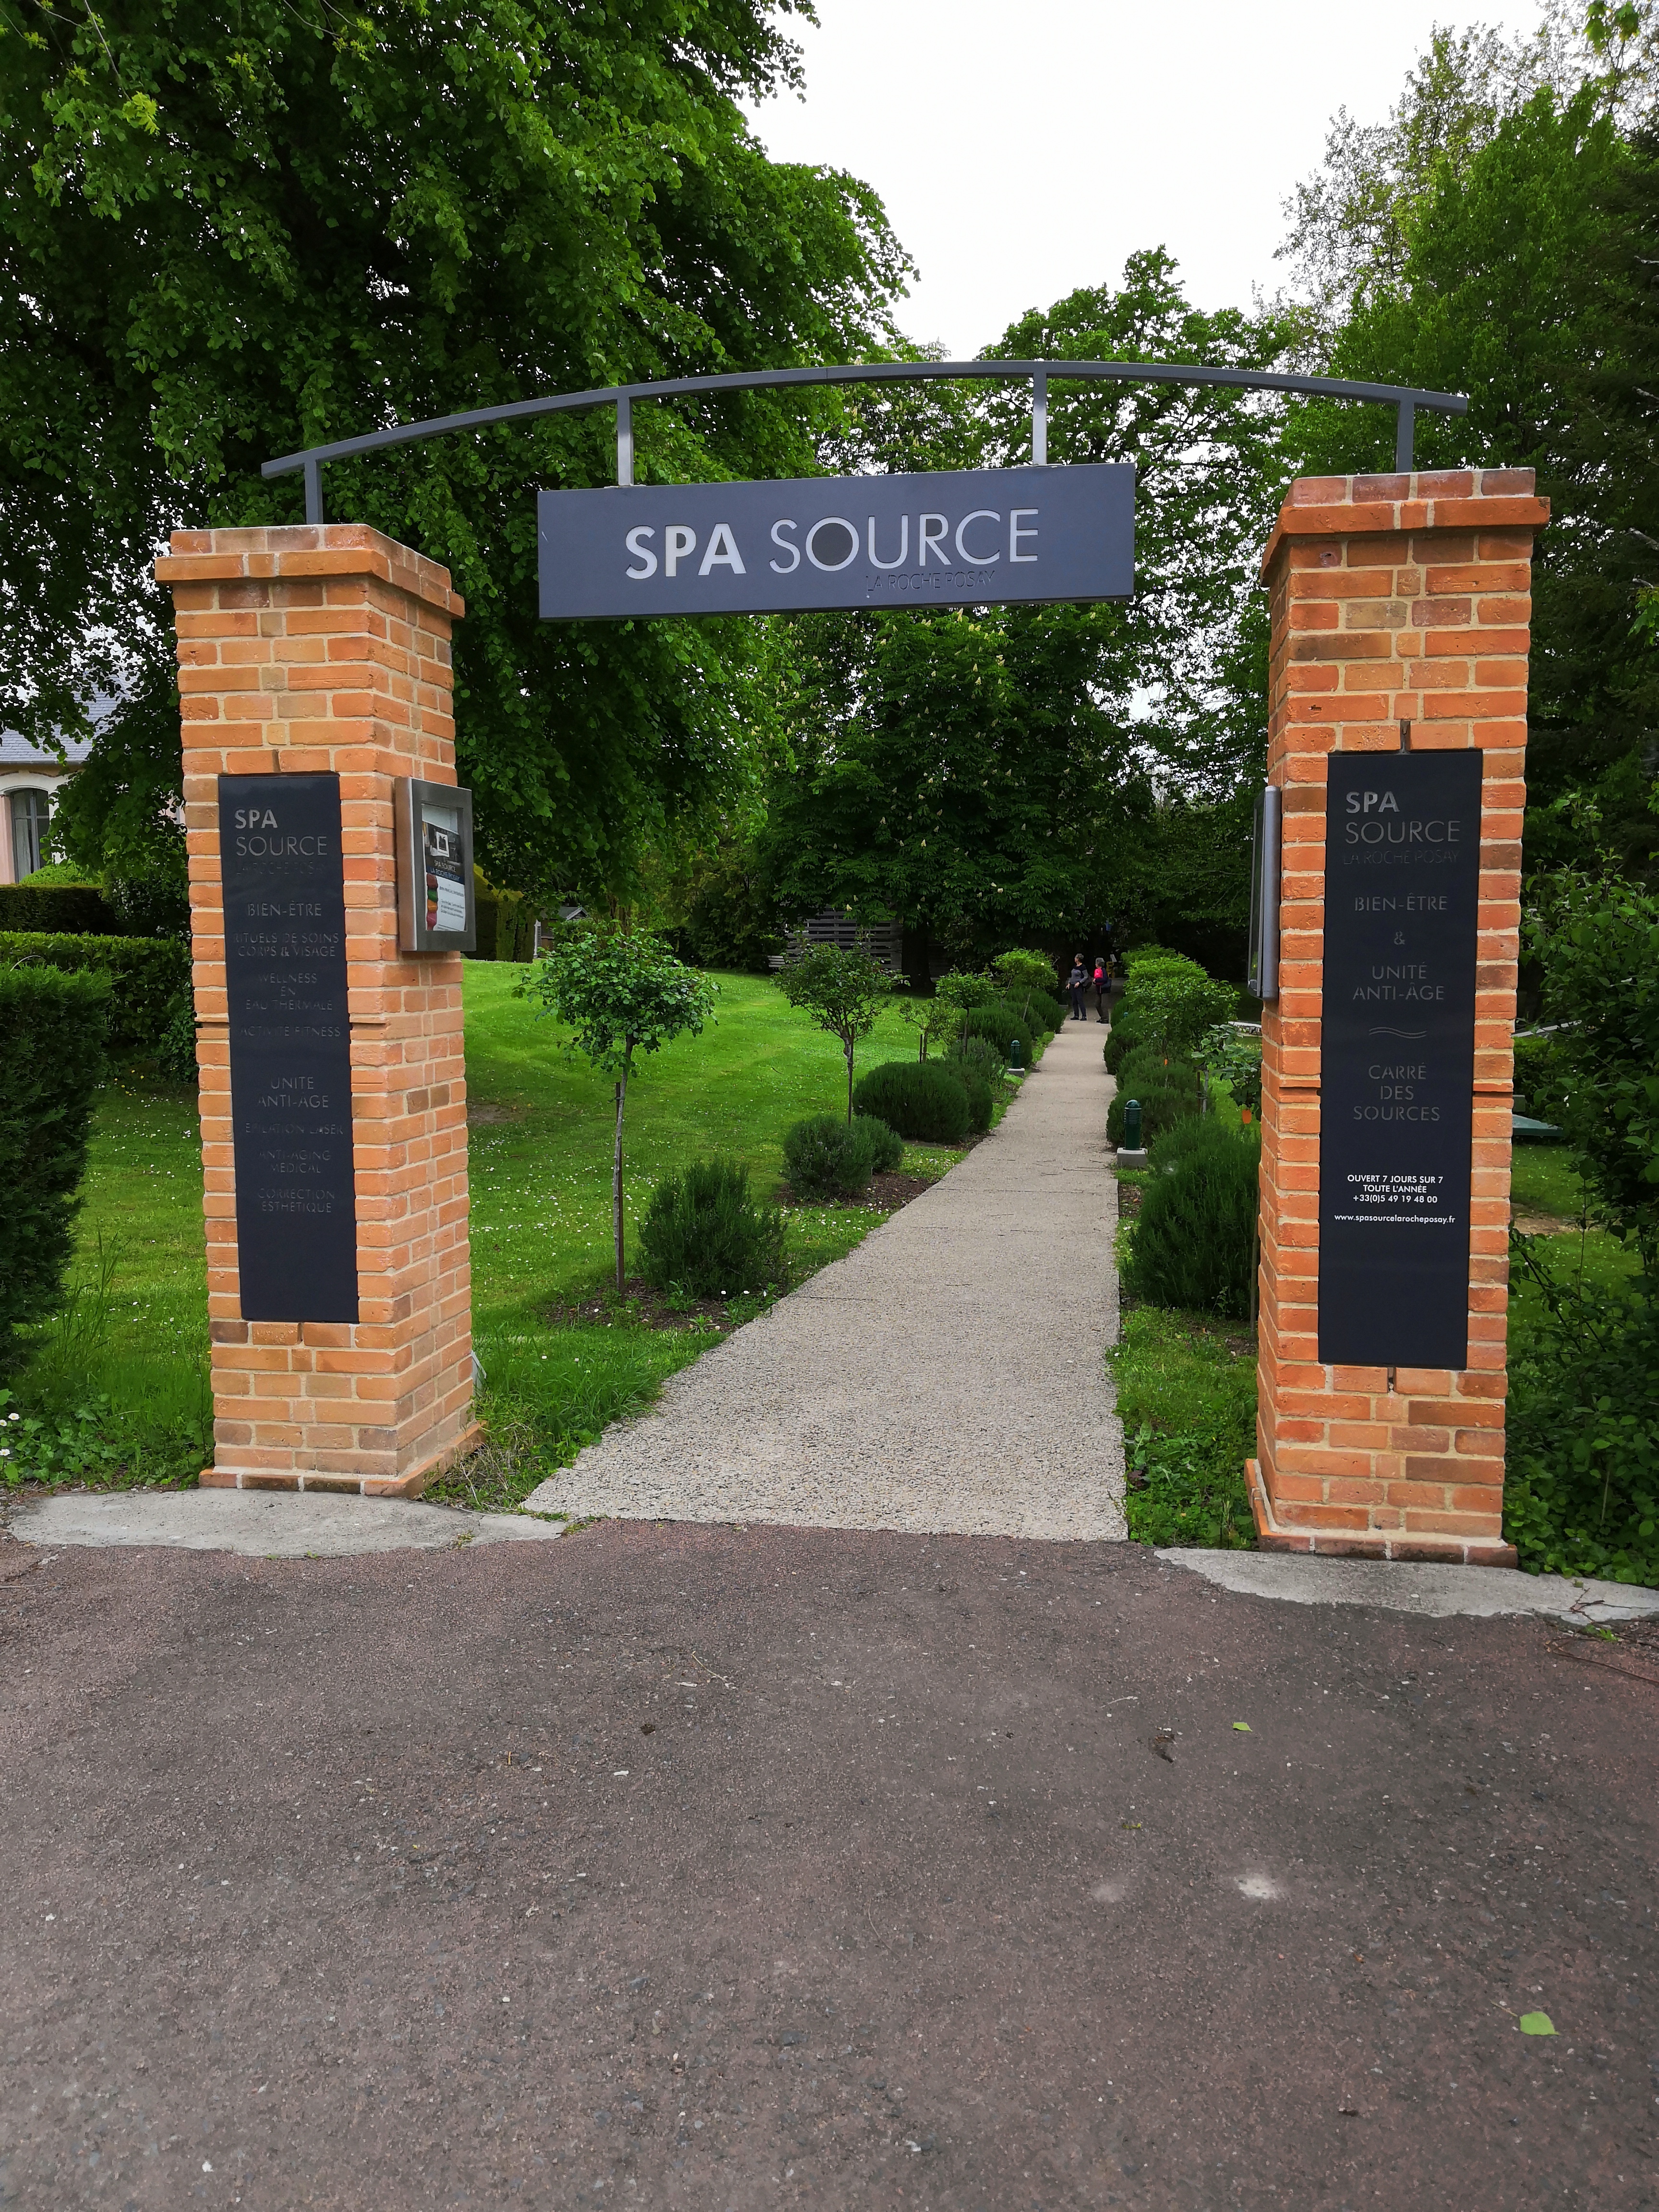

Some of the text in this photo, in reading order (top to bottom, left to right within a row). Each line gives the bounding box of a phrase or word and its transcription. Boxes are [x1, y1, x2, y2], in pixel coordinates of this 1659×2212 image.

[626, 508, 1038, 579] SPA SOURCE
[866, 570, 996, 591] LA ROCHE POSAY
[1346, 791, 1400, 813] SPA
[234, 809, 278, 829] SPA
[1345, 820, 1461, 844] SOURCE
[236, 836, 327, 856] SOURCE
[1344, 849, 1460, 865] LA ROCHE POSAY
[248, 901, 322, 916] BIEN-ÊTRE
[1355, 892, 1448, 911] BIEN-ÊTRE
[233, 933, 339, 943] RITUELS DE SOINS
[1394, 931, 1405, 945] &
[238, 946, 276, 957] CORPS
[291, 946, 336, 957] VISAGE
[1372, 962, 1427, 979] UNITÉ
[258, 973, 318, 983] WELLNESS
[280, 986, 296, 997] EN
[1352, 982, 1444, 1000] ANTI-ÂGE
[246, 999, 332, 1010] EAU THERMALE
[295, 1026, 340, 1037] FITNESS
[1369, 1062, 1427, 1080] CARRÉ
[1380, 1086, 1414, 1100] DES
[1353, 1106, 1441, 1121] SOURCES
[258, 1149, 332, 1161] ANTI-AGING
[1347, 1174, 1381, 1182] OUVERT
[1390, 1175, 1417, 1183] JOURS
[258, 1188, 335, 1200] CORRECTION
[1363, 1184, 1427, 1193] TOUTE L'ANNÉE
[1353, 1194, 1385, 1203] +33(0)5
[1334, 1214, 1456, 1225] www.spasourcelarocheposay.fr
